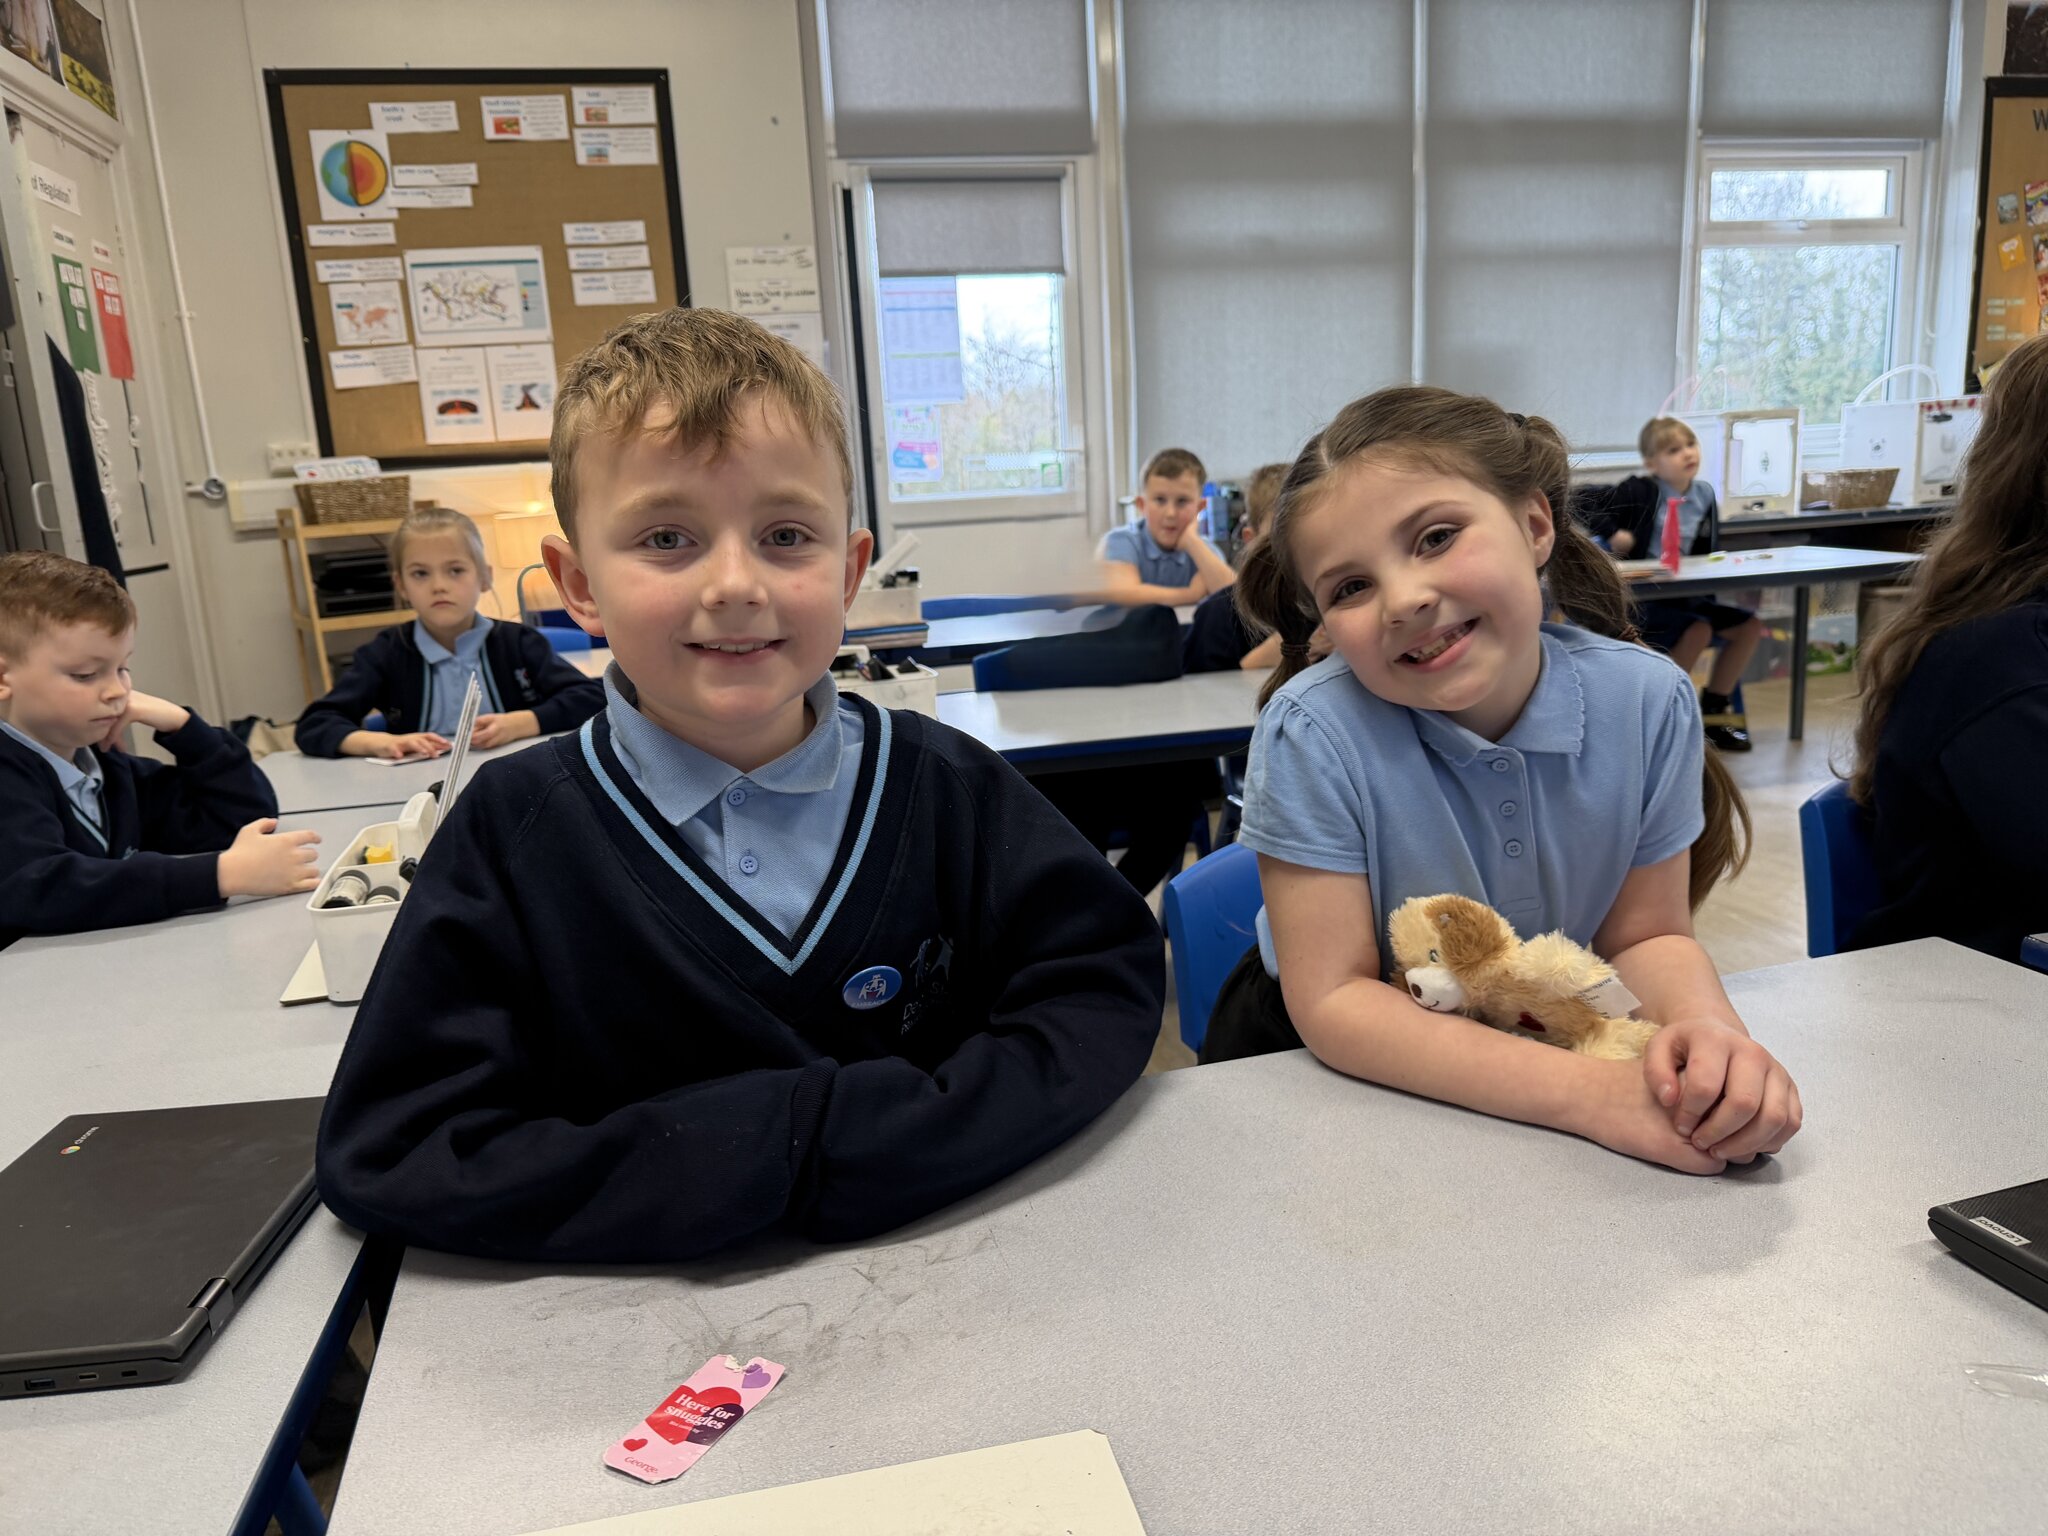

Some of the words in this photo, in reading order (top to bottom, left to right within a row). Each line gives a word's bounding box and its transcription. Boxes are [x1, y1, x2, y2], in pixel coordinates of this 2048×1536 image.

[74, 1126, 100, 1145] chrome
[1976, 1218, 2023, 1243] Lenovo
[664, 1405, 726, 1430] snuggles
[675, 1394, 710, 1413] Here
[709, 1406, 736, 1420] for
